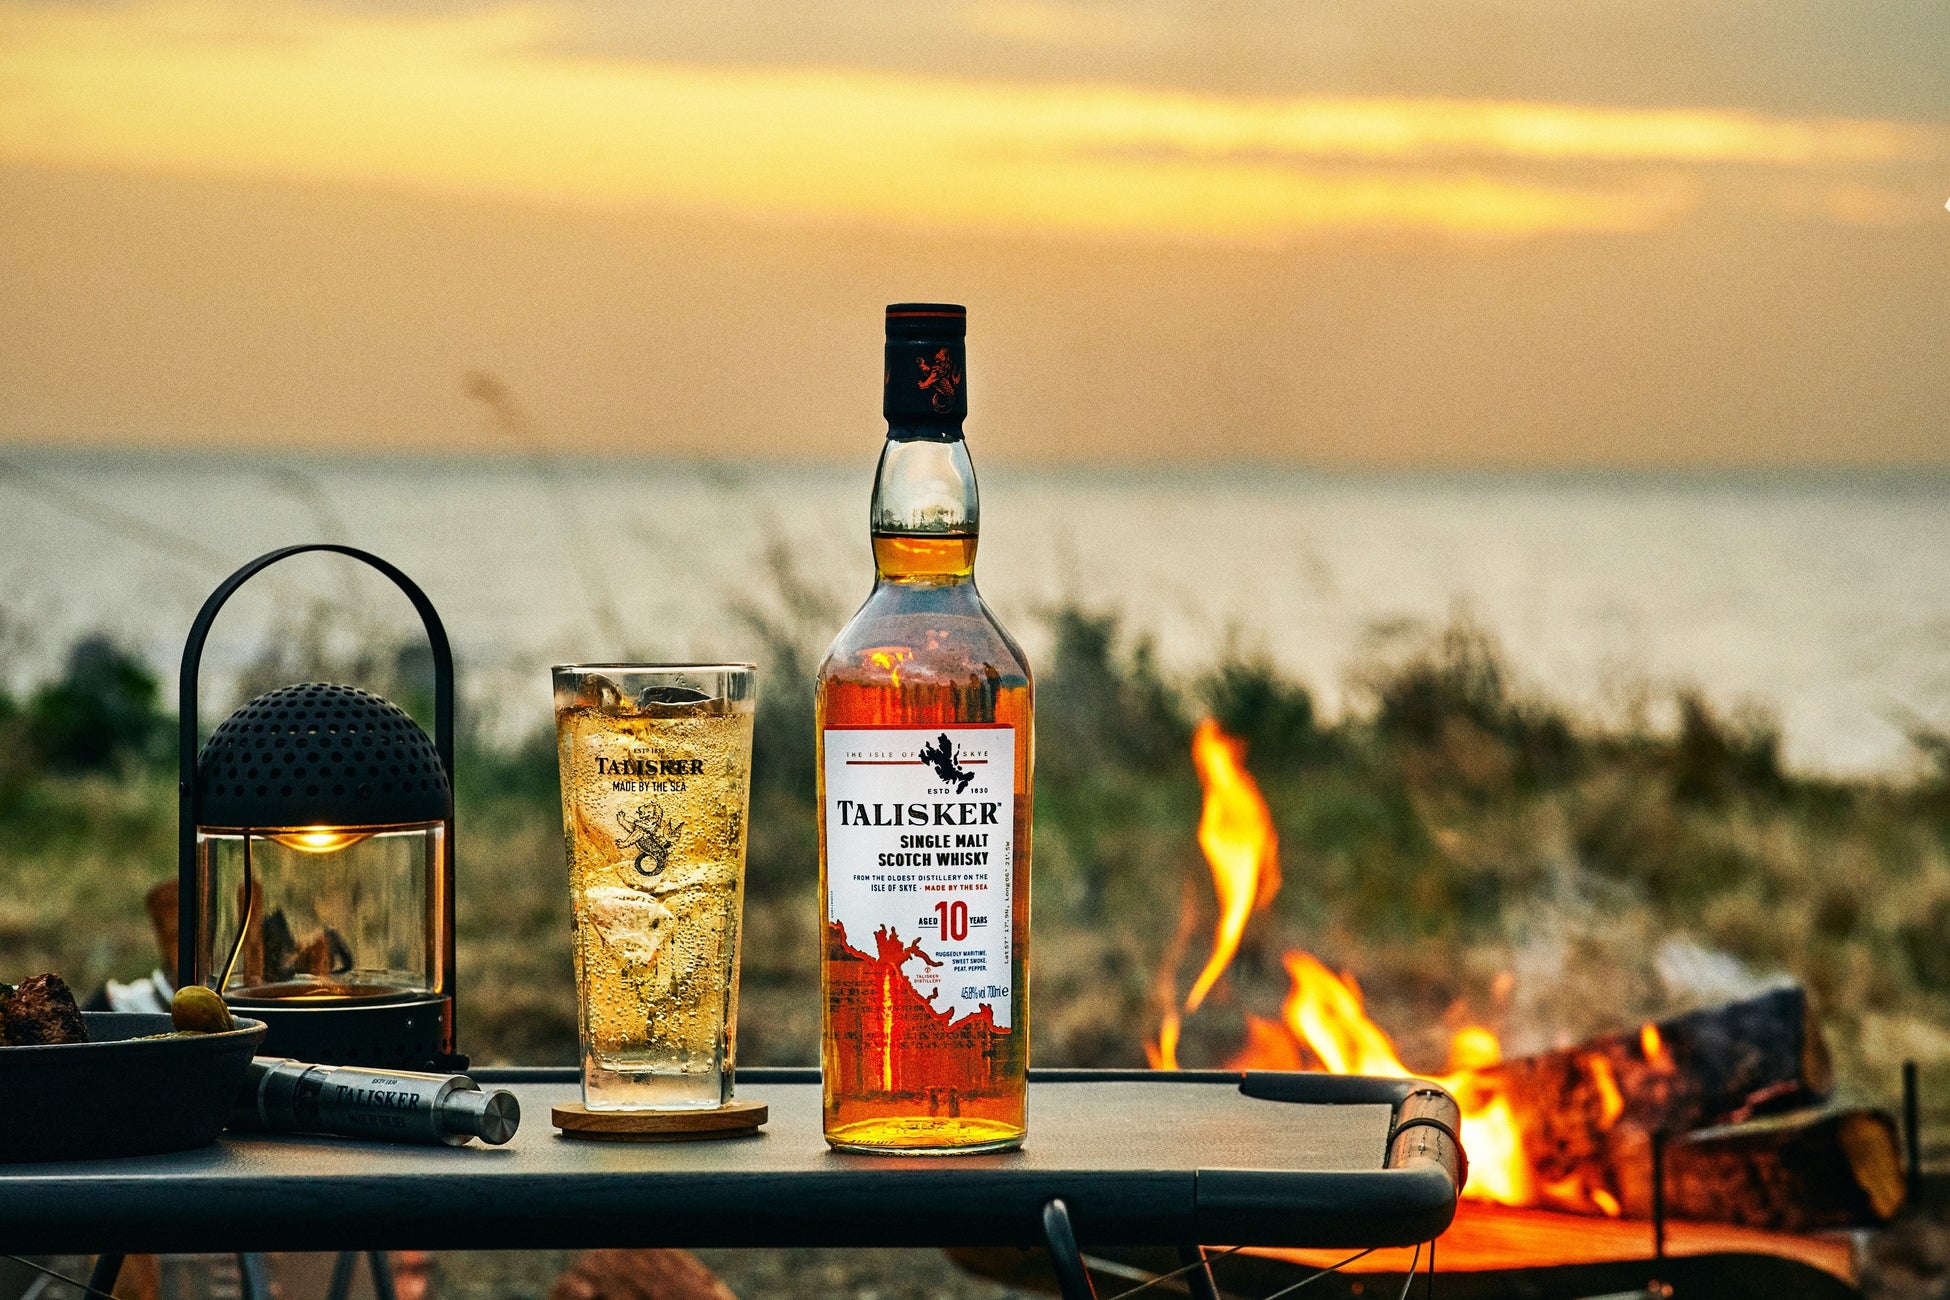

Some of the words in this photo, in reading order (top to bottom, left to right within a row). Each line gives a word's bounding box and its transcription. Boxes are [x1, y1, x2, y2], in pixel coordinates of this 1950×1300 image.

[595, 755, 704, 776] TALISKER
[612, 781, 636, 792] MADE
[638, 781, 650, 792] BY
[652, 781, 667, 792] THE
[670, 781, 687, 792] SEA
[837, 800, 999, 826] TALISKER
[900, 834, 950, 848] SINGLE
[955, 833, 988, 848] MALT
[878, 853, 931, 866] SCOTCH
[936, 851, 988, 866] WHISKY
[871, 884, 885, 892] ISLE
[888, 884, 897, 892] OF
[899, 884, 917, 892] SKYE
[918, 917, 938, 925] AGED
[934, 900, 968, 942] 10
[969, 916, 988, 924] YEARS
[336, 1085, 420, 1111] TALISKER
